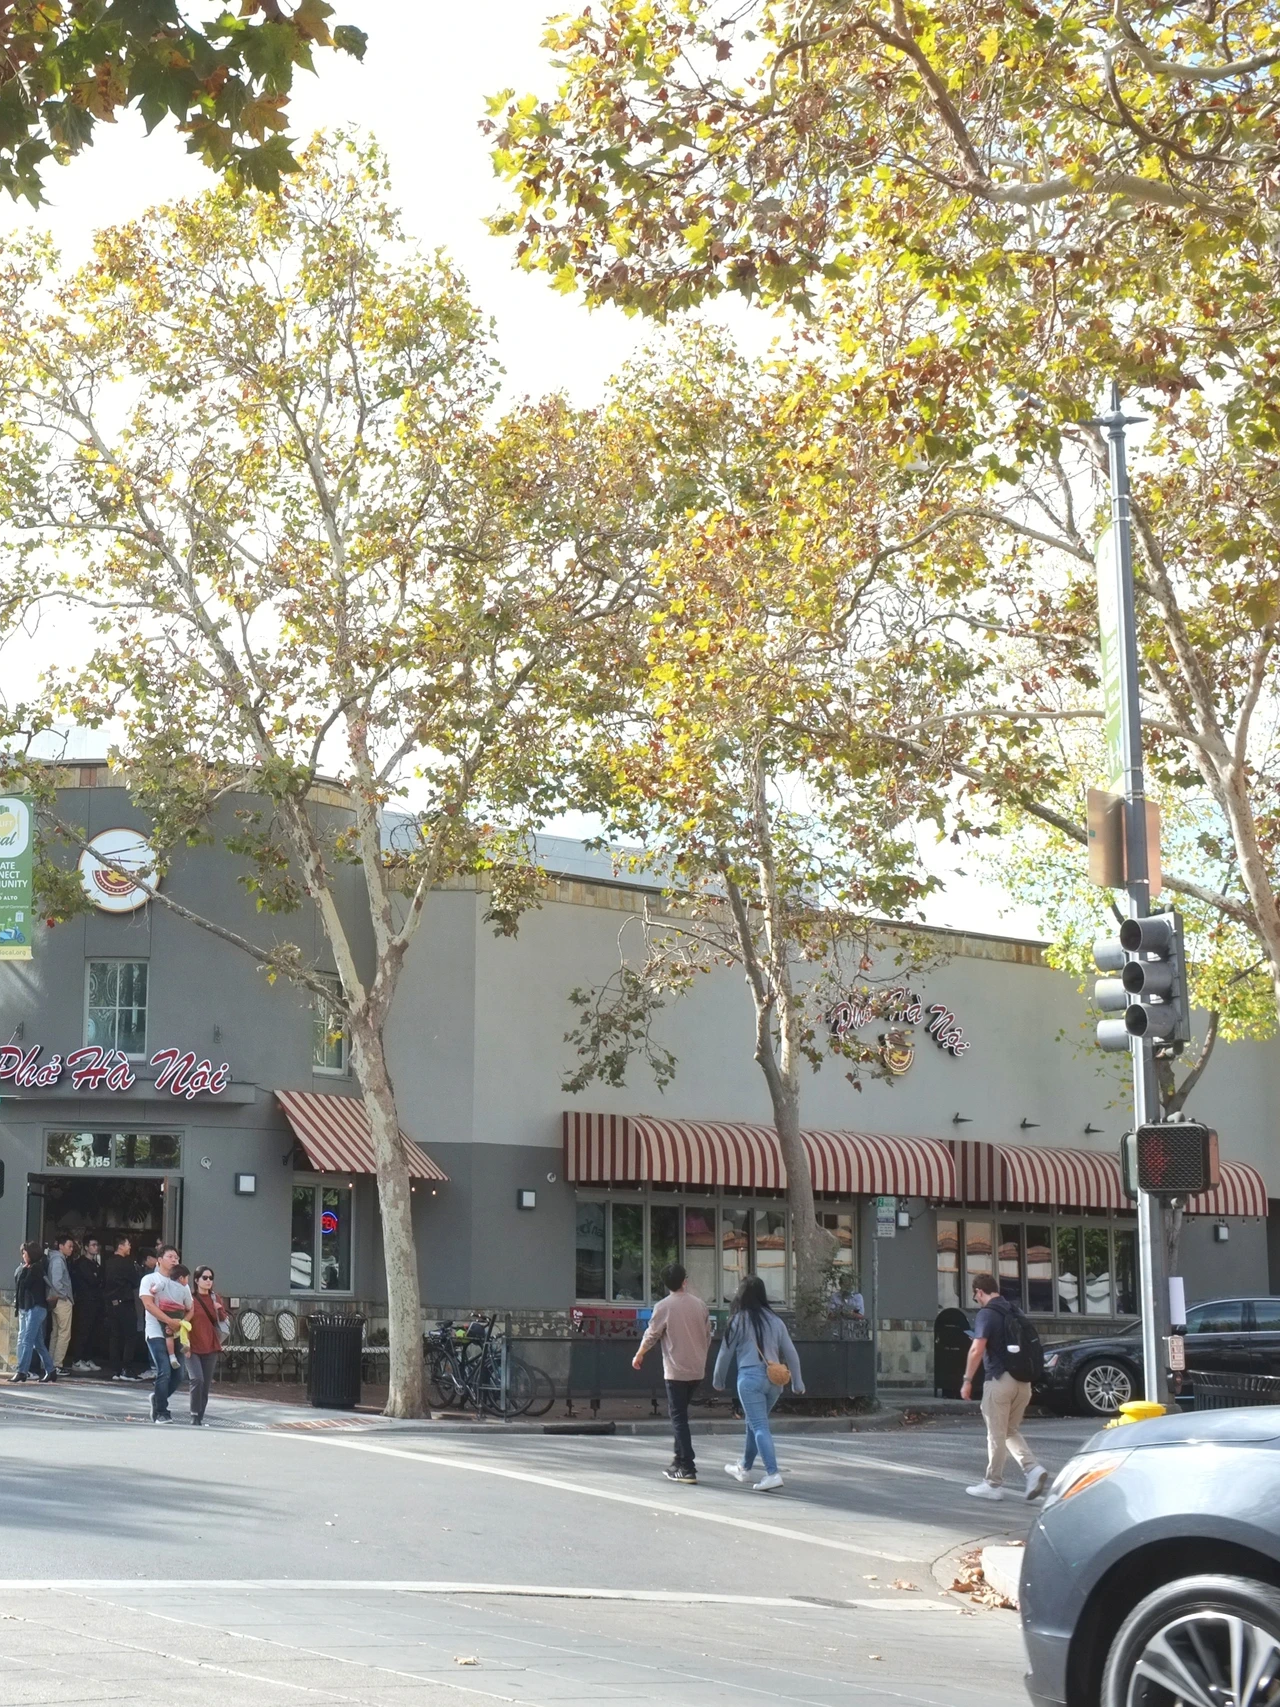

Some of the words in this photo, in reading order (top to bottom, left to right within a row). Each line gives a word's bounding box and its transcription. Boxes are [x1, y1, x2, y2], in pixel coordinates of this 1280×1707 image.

[67, 1045, 136, 1091] Hà
[150, 1047, 230, 1100] Nội
[88, 1156, 111, 1168] 185
[321, 1216, 337, 1232] PEN
